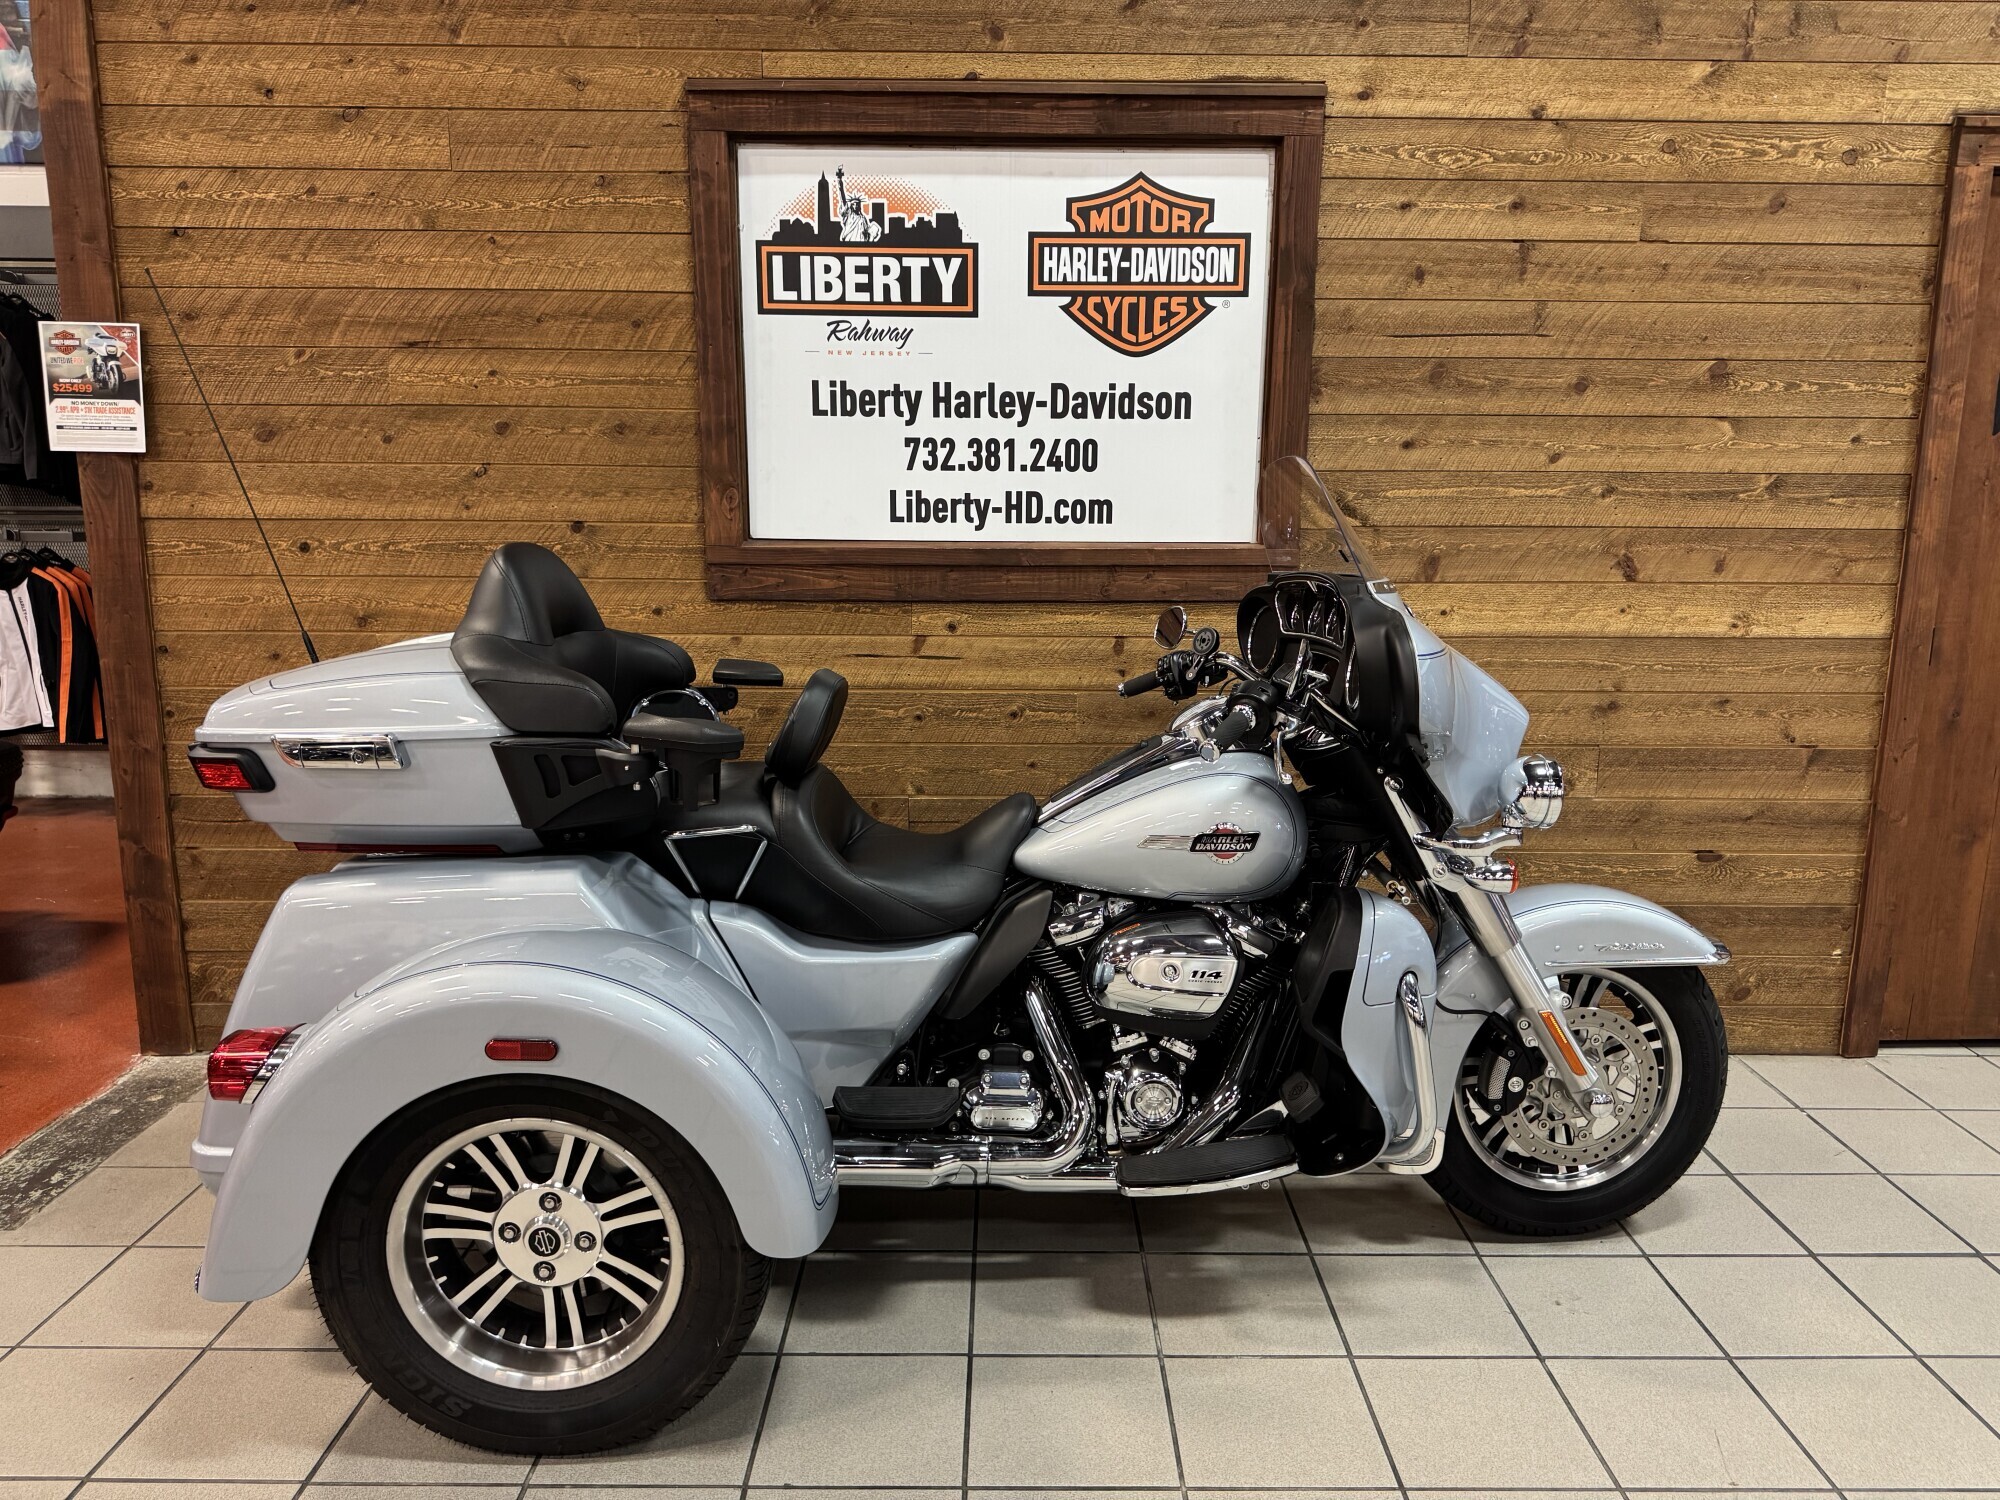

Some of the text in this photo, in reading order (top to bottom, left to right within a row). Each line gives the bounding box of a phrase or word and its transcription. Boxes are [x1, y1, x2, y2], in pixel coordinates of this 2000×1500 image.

[1089, 190, 1191, 233] MOTOR
[772, 255, 963, 303] LIBERTY
[1043, 246, 1235, 284] HARLEY-DAVIDSON
[826, 318, 914, 350] Rahway
[1087, 296, 1188, 343] CYCLES
[52, 383, 93, 392] $25499
[811, 379, 1193, 428] Liberty Harley-Davidson
[108, 407, 136, 415] ASSISTANCE
[904, 436, 1099, 473] 732.381.2400
[889, 489, 1113, 531] Liberty-HD.com
[1194, 842, 1253, 851] DAVIDSON
[1190, 969, 1223, 980] 114
